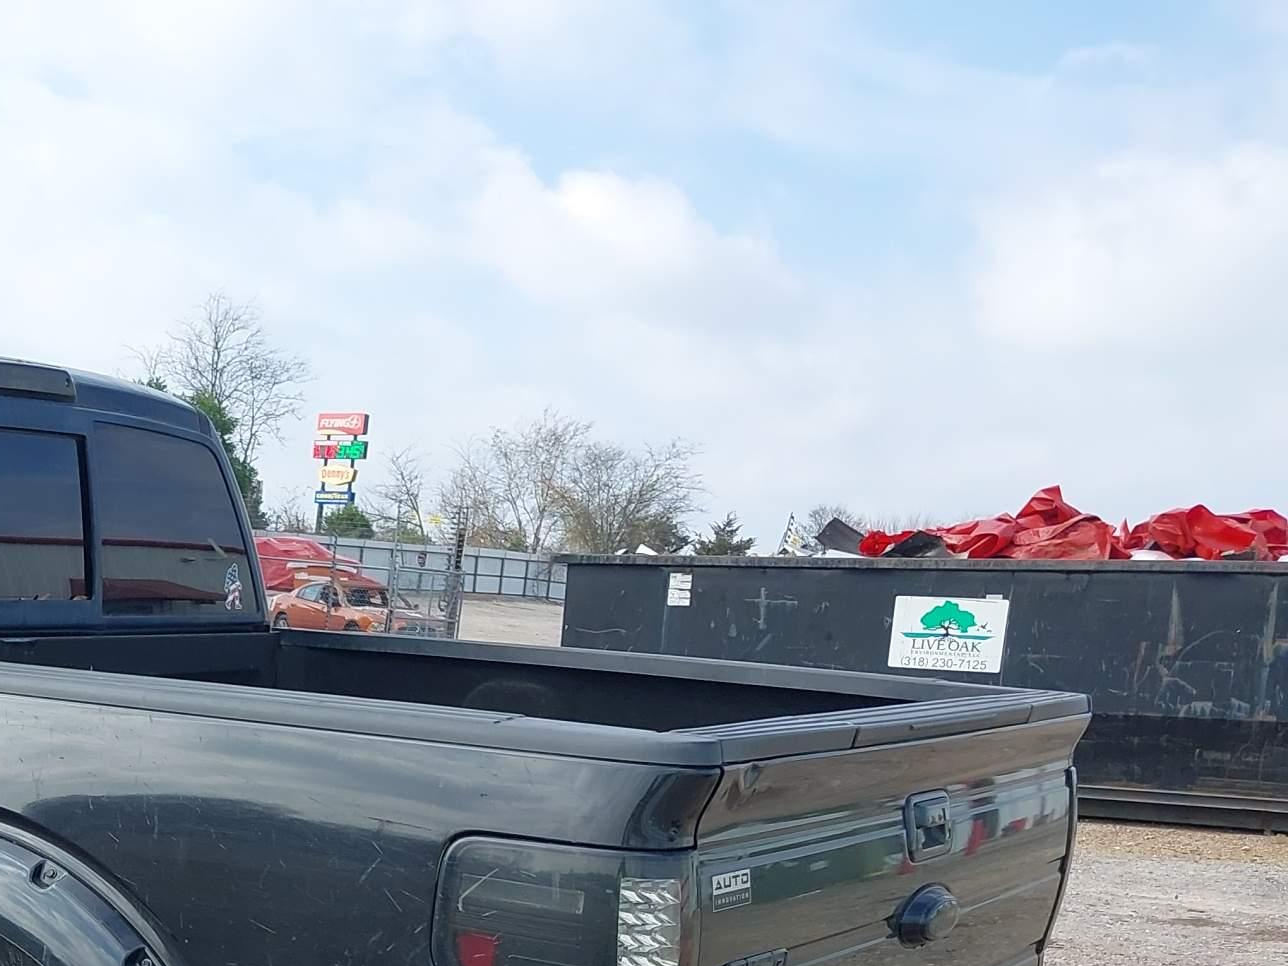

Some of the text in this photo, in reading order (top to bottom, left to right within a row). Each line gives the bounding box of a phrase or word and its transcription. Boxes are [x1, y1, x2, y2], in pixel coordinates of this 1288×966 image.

[900, 656, 987, 670] (318) 230-7125
[714, 872, 749, 890] AUTO
